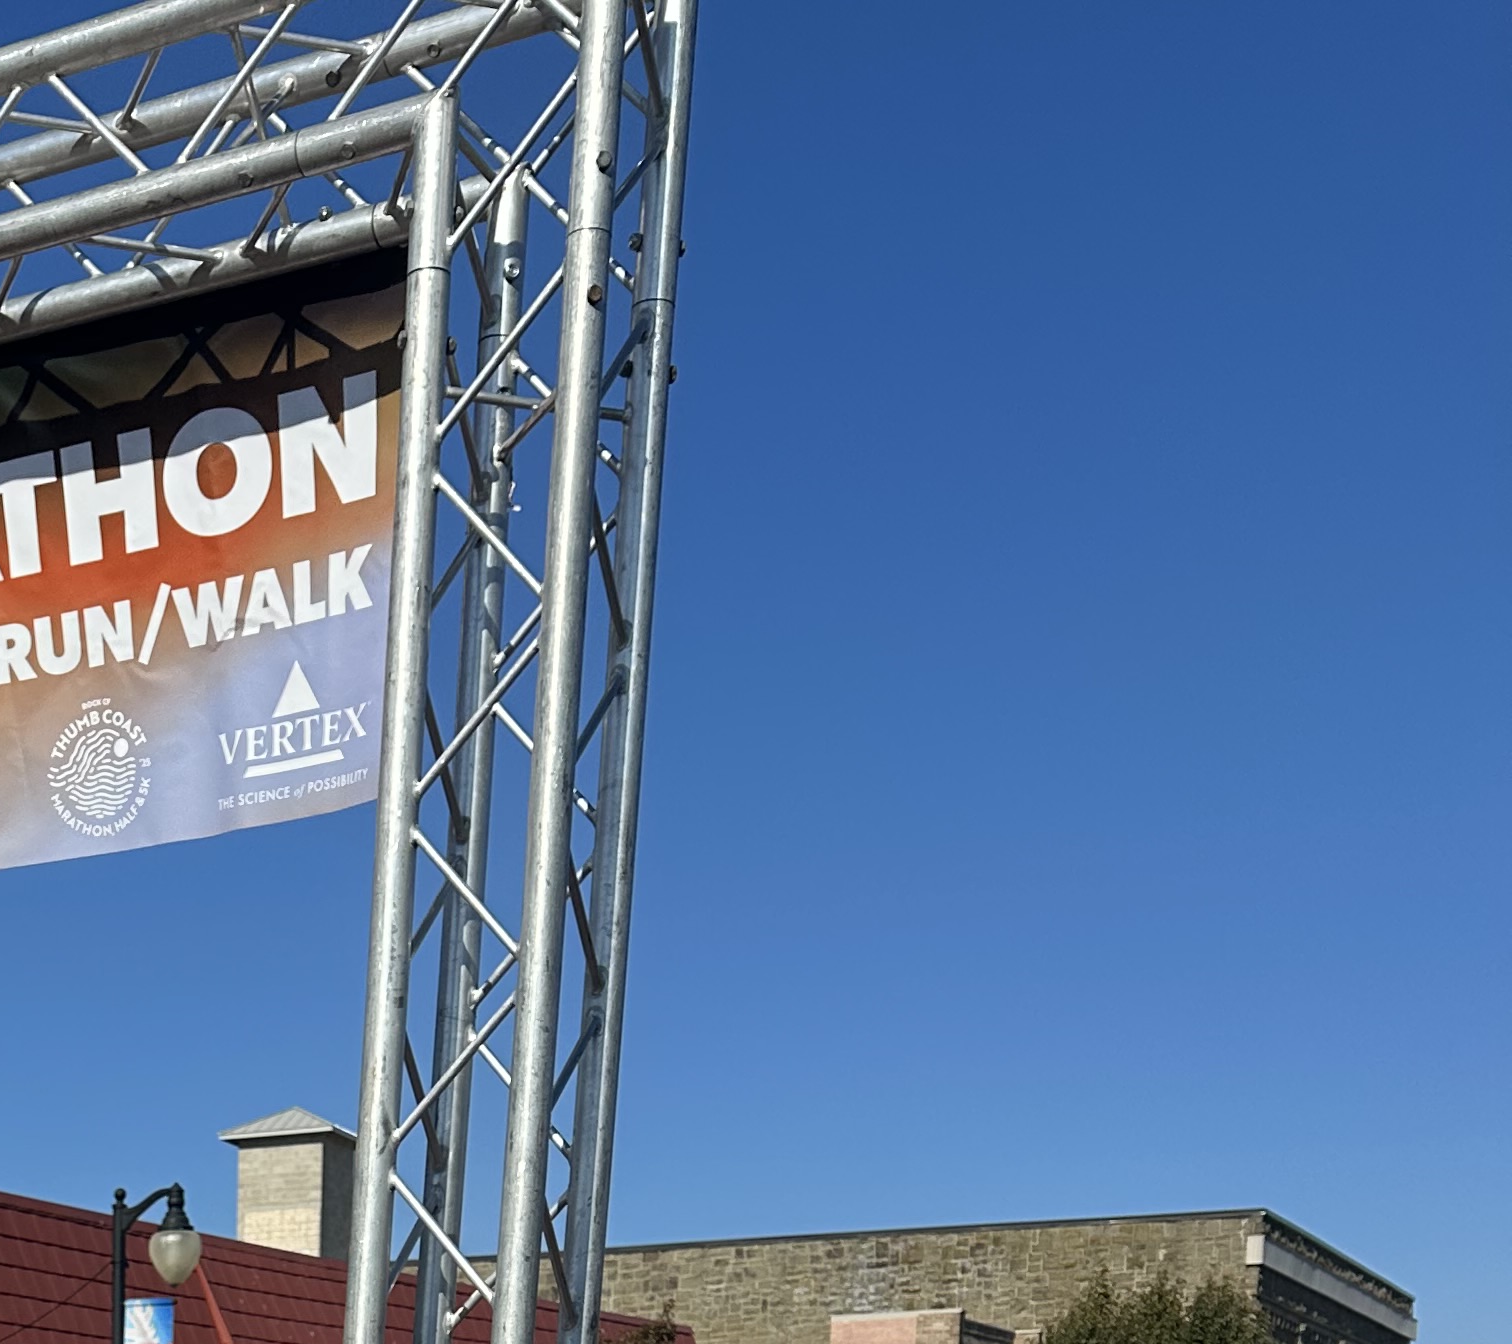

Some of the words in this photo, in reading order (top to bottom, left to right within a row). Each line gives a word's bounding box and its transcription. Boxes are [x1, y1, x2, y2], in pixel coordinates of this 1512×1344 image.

[50, 710, 100, 759] THUMB
[101, 709, 147, 746] COAST
[218, 701, 367, 765] VERTEX
[114, 804, 139, 833] HALF
[138, 777, 152, 796] 5K
[218, 795, 235, 811] THE
[238, 786, 291, 806] SCIENCE
[293, 783, 307, 800] of
[307, 768, 369, 794] POSSIBILITY
